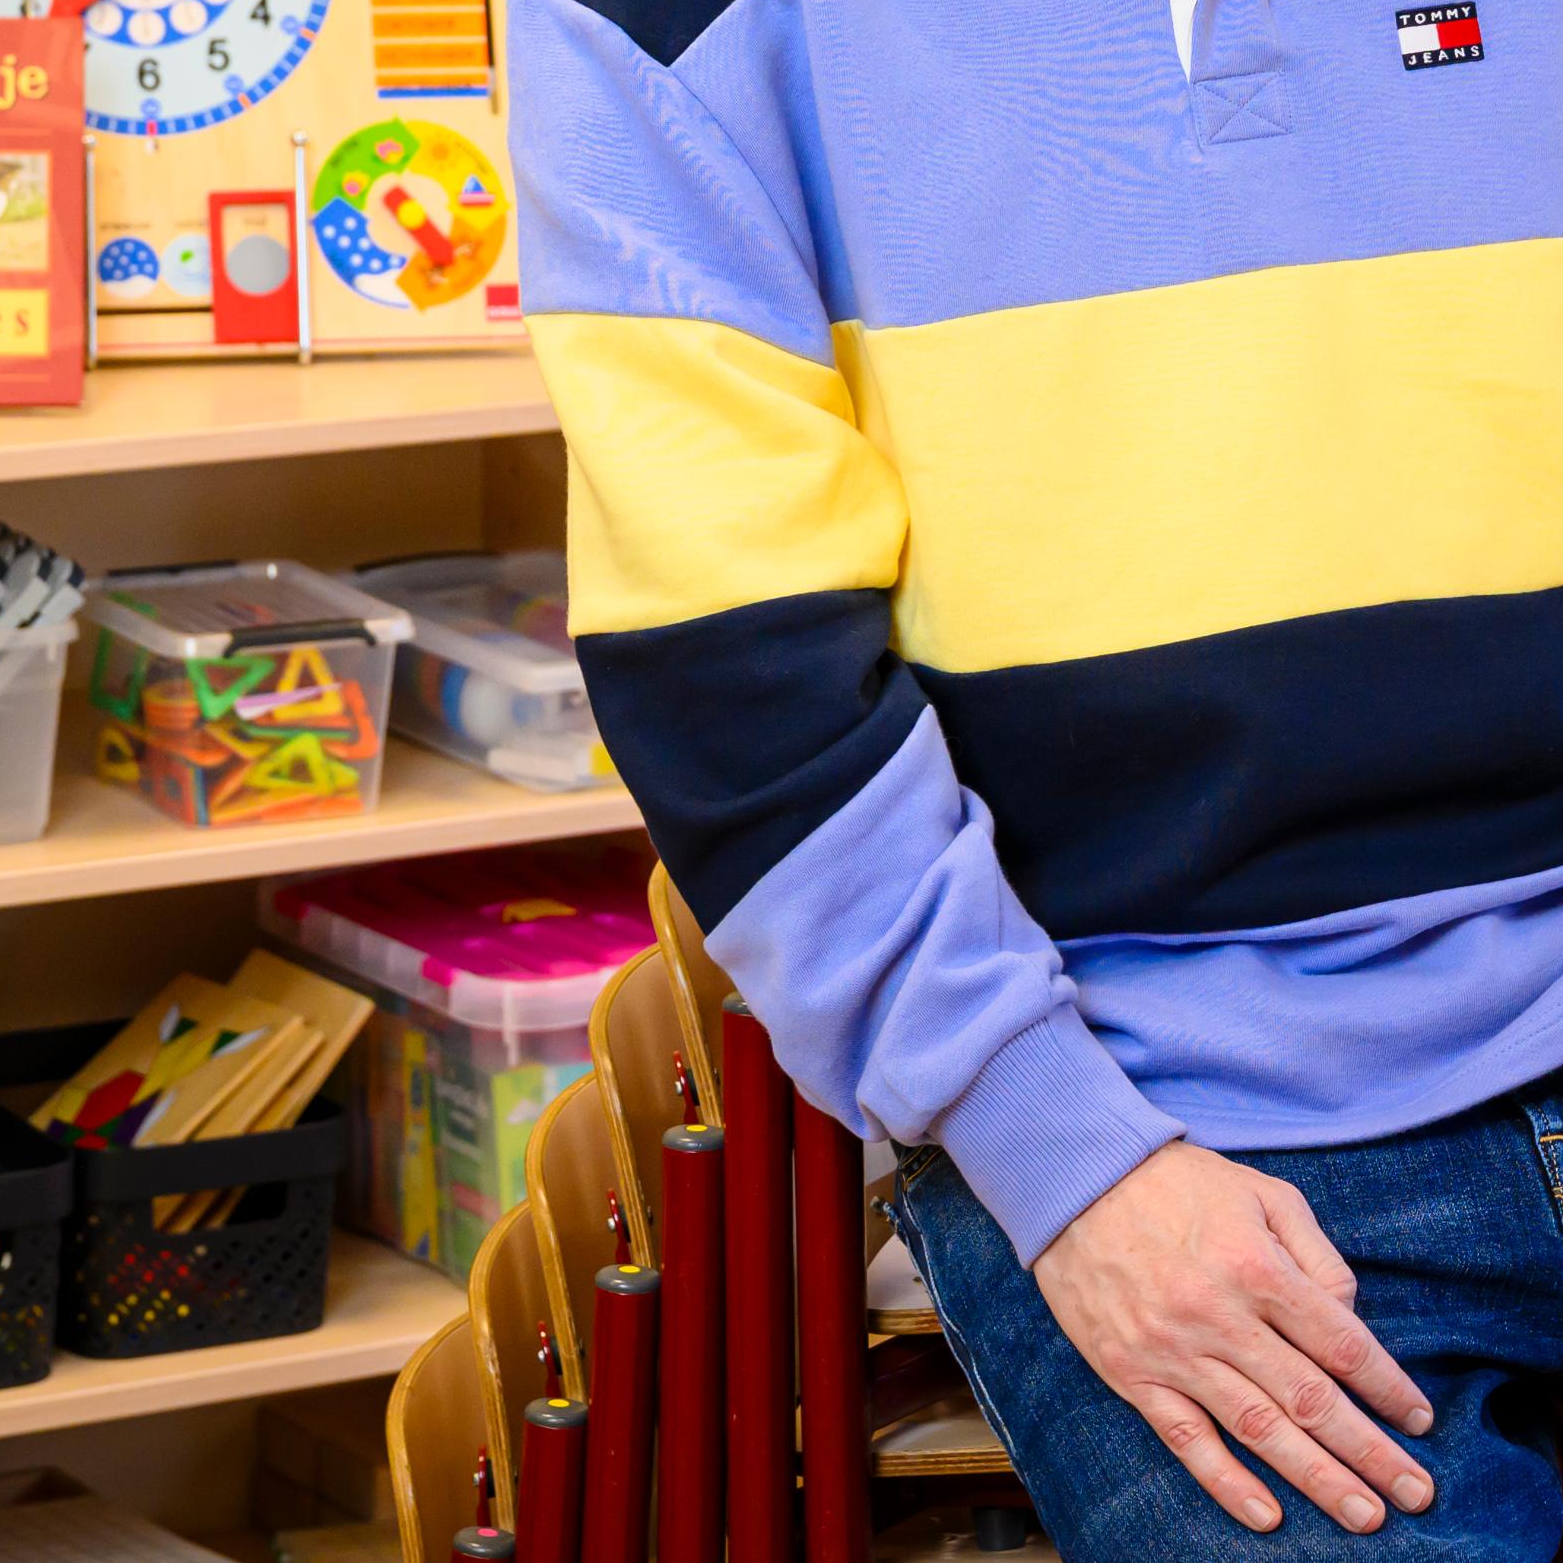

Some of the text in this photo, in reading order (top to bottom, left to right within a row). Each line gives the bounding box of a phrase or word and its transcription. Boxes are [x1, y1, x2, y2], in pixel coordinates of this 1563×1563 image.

[1399, 5, 1472, 26] TOMMY
[207, 38, 230, 72] 5
[1407, 45, 1480, 66] JEANS
[137, 58, 161, 91] 6
